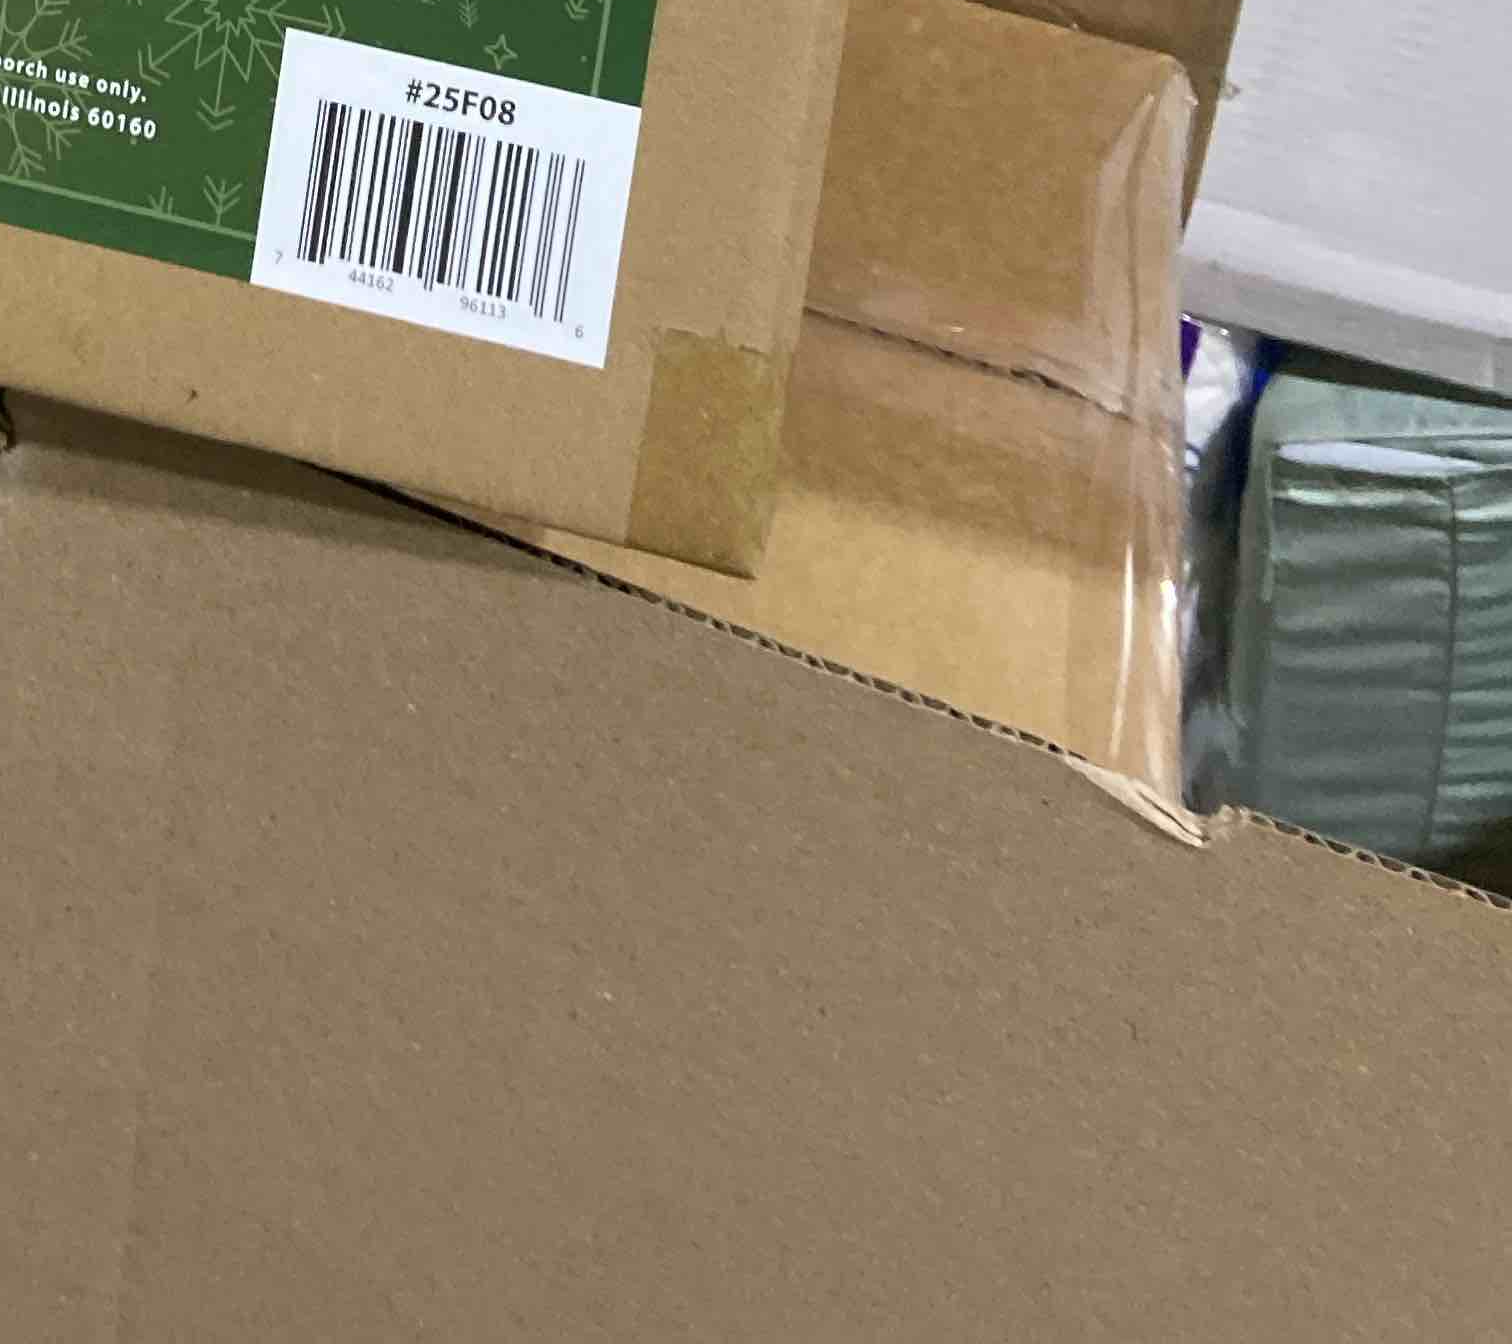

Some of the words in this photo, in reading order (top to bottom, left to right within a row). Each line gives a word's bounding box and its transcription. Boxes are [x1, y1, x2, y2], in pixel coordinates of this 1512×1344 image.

[56, 69, 89, 88] use
[97, 79, 146, 104] only.
[406, 79, 516, 126] #25F08
[3, 86, 79, 121] Illinois
[88, 107, 155, 138] 60160
[347, 269, 394, 293] 44162
[459, 295, 507, 321] 96113
[574, 325, 584, 339] 6
